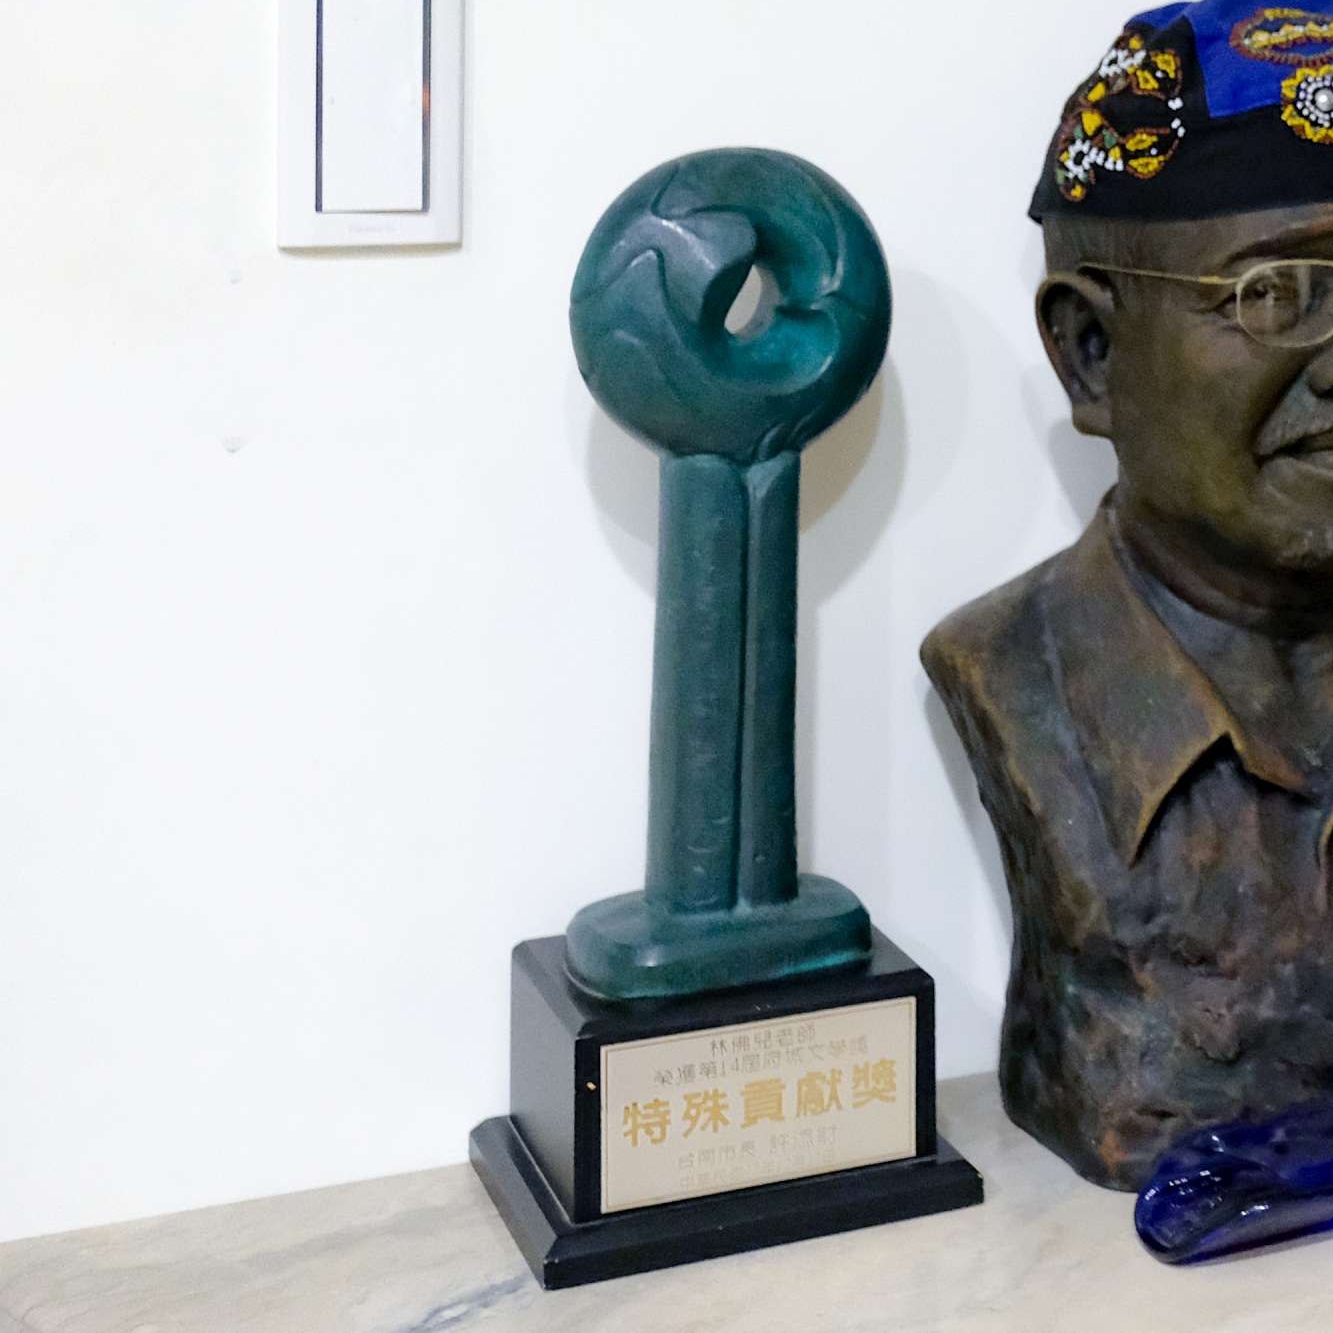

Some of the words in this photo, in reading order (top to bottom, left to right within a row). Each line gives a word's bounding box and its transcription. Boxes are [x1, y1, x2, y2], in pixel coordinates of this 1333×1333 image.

[622, 1058, 897, 1148] 特殊貢獻獎
